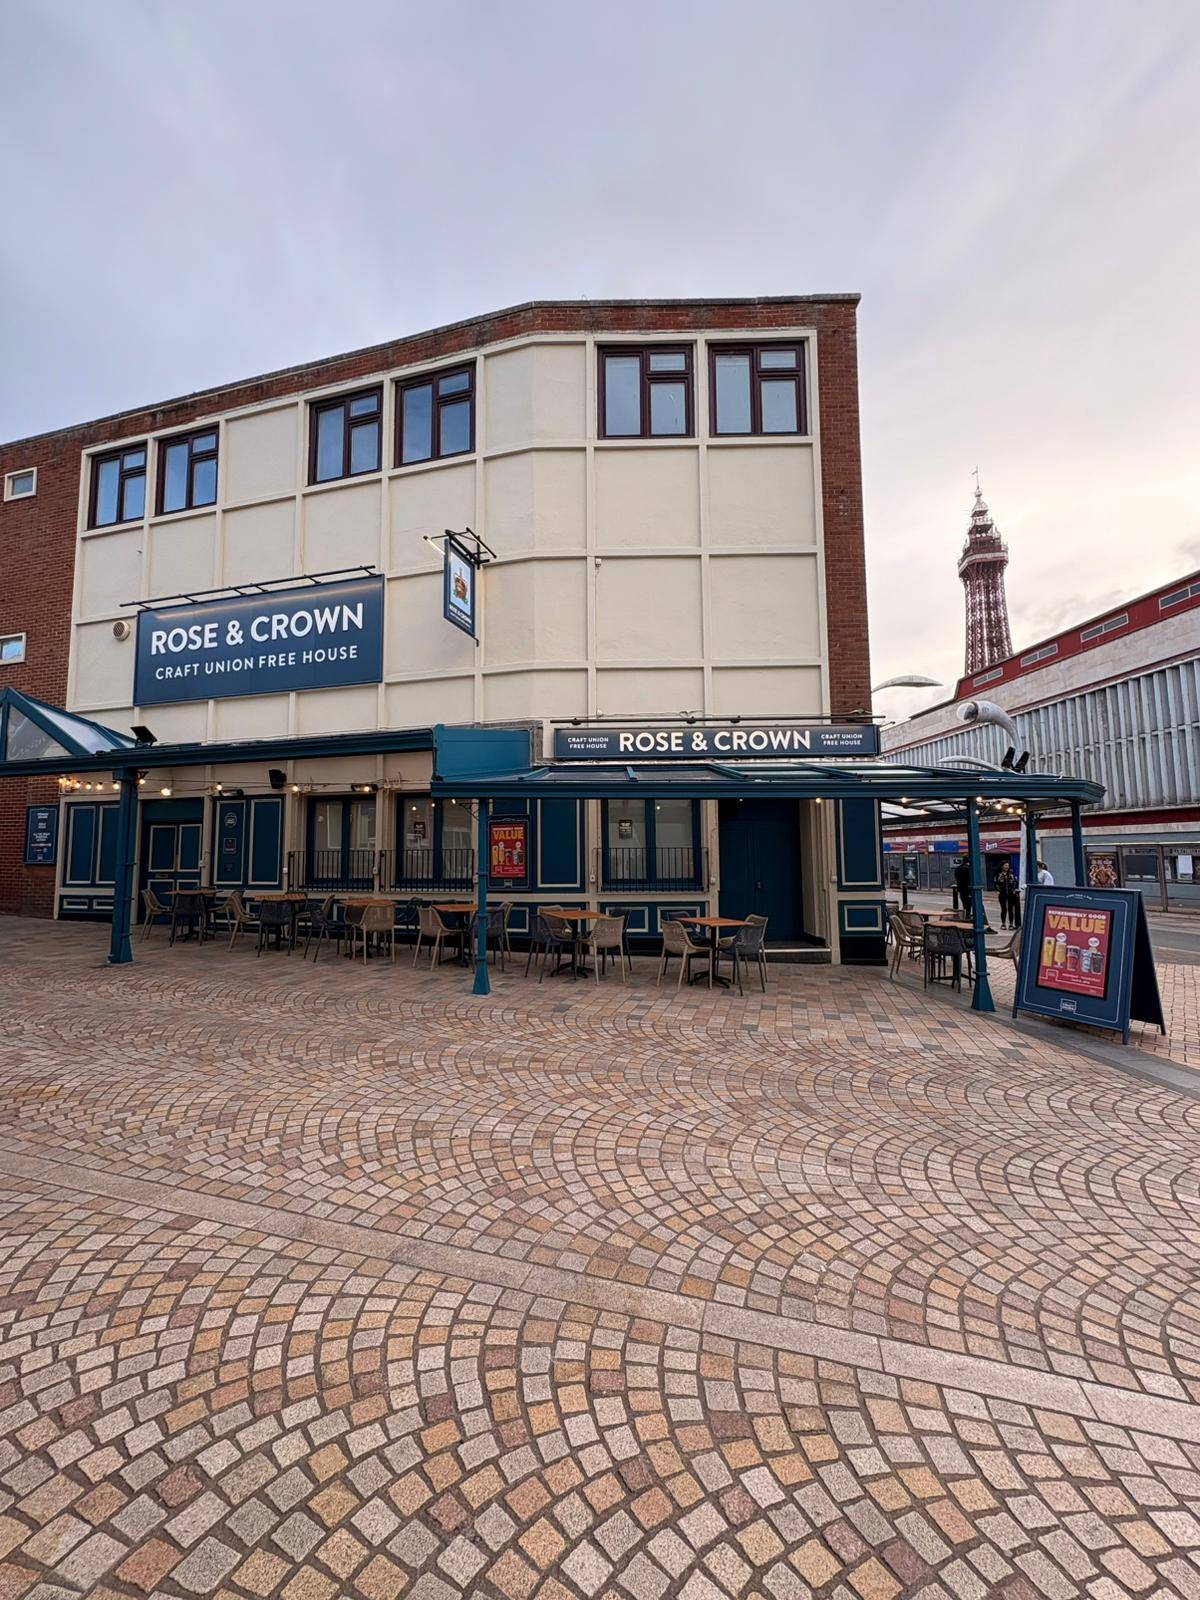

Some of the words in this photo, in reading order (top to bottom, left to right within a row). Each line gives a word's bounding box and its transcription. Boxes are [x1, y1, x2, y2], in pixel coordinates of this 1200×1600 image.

[150, 622, 219, 655] ROSE
[226, 620, 244, 646] &
[250, 603, 363, 642] CROWN
[155, 663, 200, 680] CRAFT
[205, 657, 254, 675] UNION
[258, 652, 296, 669] FREE
[302, 645, 358, 664] HOUSE
[619, 732, 684, 752] ROSE
[691, 731, 708, 751] &
[714, 730, 811, 751] CROWN
[492, 829, 525, 841] VALUE
[1048, 915, 1106, 934] VALUE
